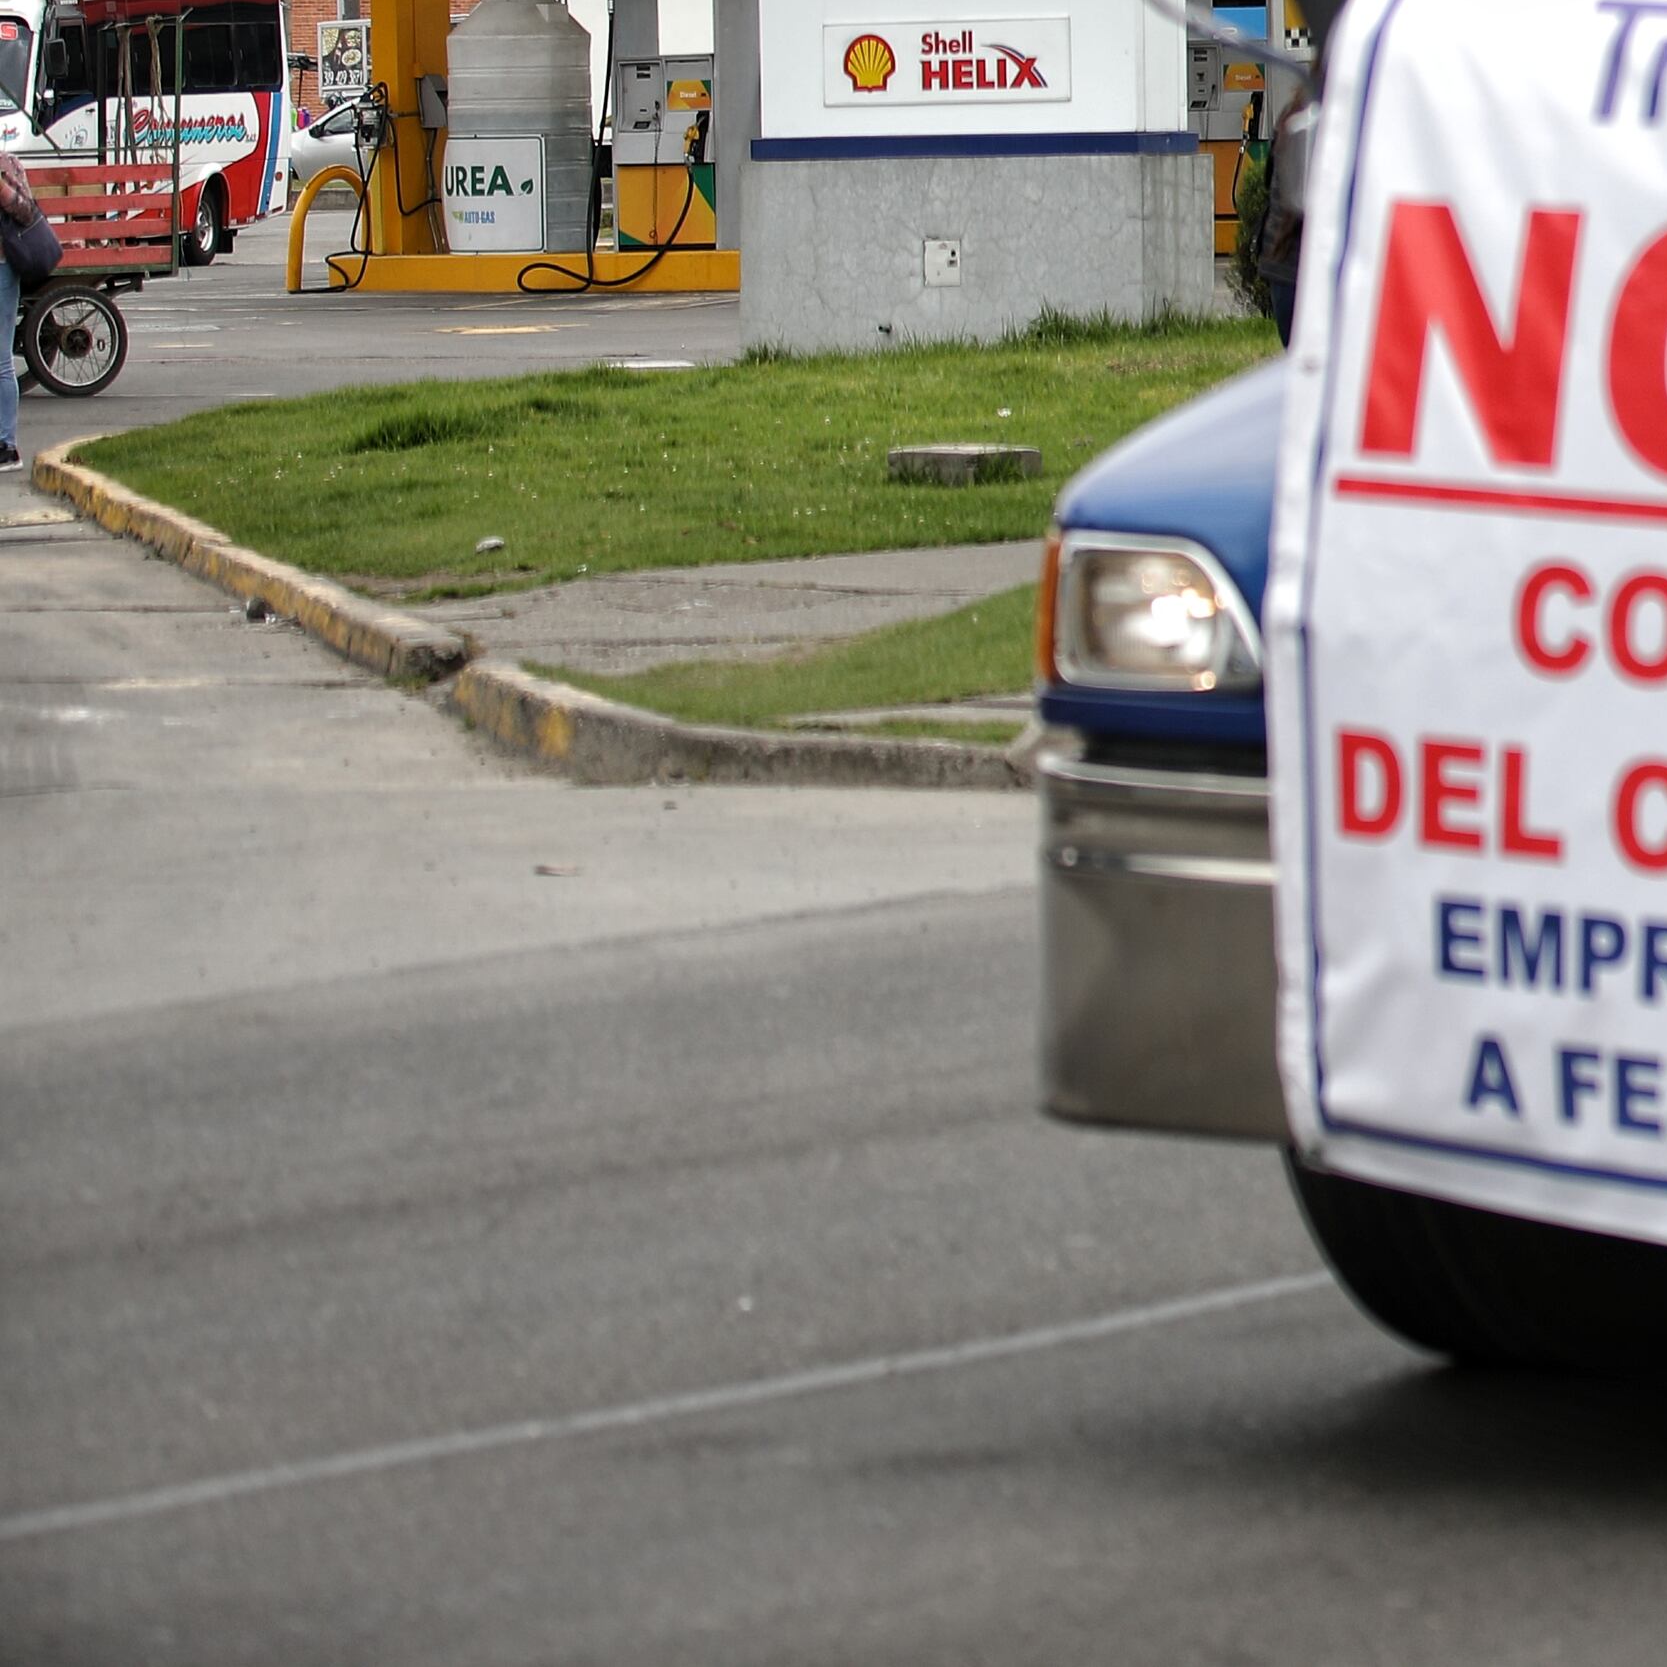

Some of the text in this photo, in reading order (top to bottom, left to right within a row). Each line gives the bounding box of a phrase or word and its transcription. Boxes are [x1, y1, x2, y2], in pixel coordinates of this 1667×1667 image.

[921, 30, 973, 55] Shell
[921, 55, 1047, 91] HELIX
[445, 165, 515, 197] UREA
[1335, 727, 1565, 862] DEL
[1462, 1036, 1521, 1117] A
